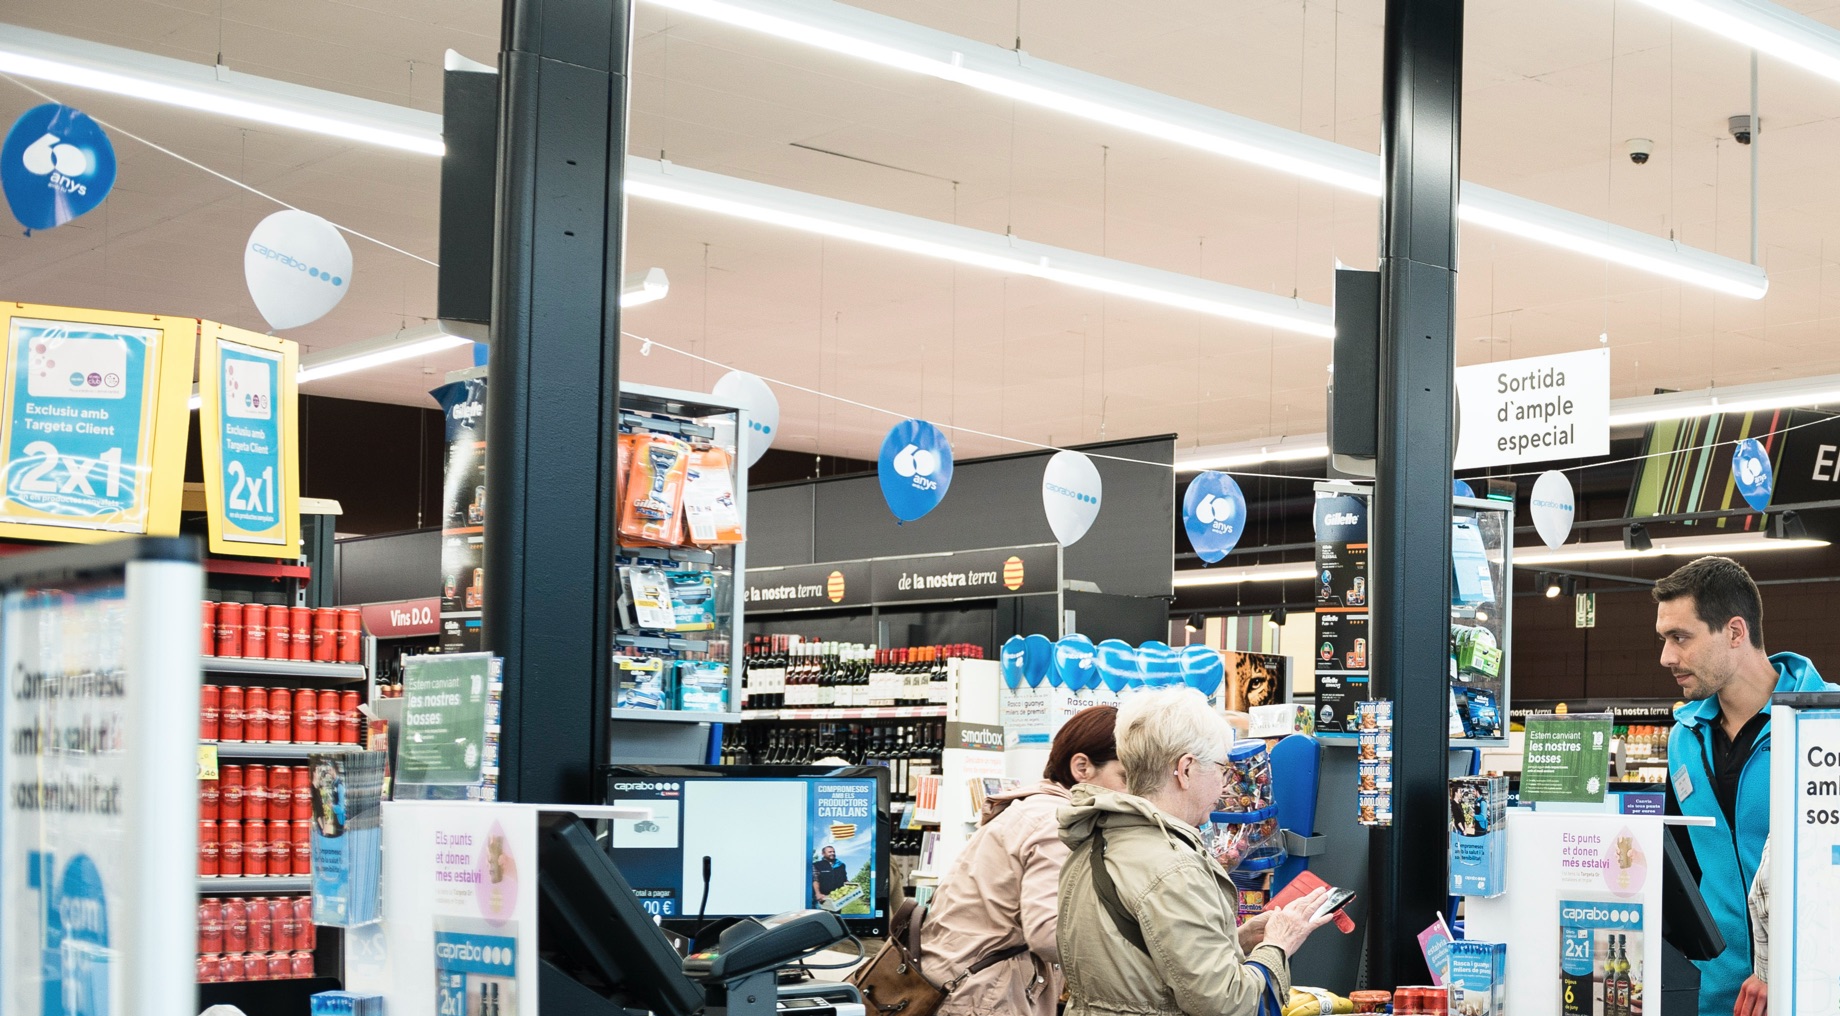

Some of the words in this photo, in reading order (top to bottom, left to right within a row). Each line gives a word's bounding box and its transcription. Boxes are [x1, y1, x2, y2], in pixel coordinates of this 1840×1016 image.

[50, 171, 87, 196] anys
[252, 242, 307, 271] caprabo
[1497, 367, 1566, 394] Sortida
[26, 403, 79, 418] Exclusiu
[81, 406, 109, 419] amb
[25, 418, 73, 434] Targeta
[76, 421, 115, 436] Client
[226, 424, 250, 437] Exclusiu
[250, 428, 265, 439] amb
[226, 438, 249, 452] Targeta
[250, 441, 269, 454] Client
[1497, 424, 1575, 455] especial
[20, 440, 123, 498] 2x1
[227, 460, 274, 513] 2x1
[913, 474, 937, 490] anys
[1045, 482, 1076, 498] caprabo
[1212, 520, 1234, 534] anys
[1324, 513, 1359, 526] Gillette
[898, 574, 912, 591] de
[913, 574, 925, 588] la
[926, 571, 966, 588] nostra
[968, 570, 997, 585] terra
[751, 587, 761, 600] la
[762, 585, 796, 600] nostra
[797, 584, 822, 598] terra
[390, 609, 411, 627] Vins
[412, 606, 433, 625] D.O.
[409, 678, 431, 690] Estem
[432, 676, 459, 689] canviant
[408, 692, 424, 708] les
[424, 692, 461, 707] nostres
[1024, 701, 1044, 709] guanya
[1067, 697, 1094, 707] Rasca
[406, 710, 441, 726] bosses
[1614, 707, 1621, 715] la
[1622, 707, 1649, 716] nostra
[1650, 707, 1669, 715] terra
[961, 729, 1003, 746] smartbox
[1531, 731, 1551, 740] Estem
[1552, 731, 1581, 740] canviant
[1530, 740, 1543, 751] les
[1545, 741, 1581, 752] nostres
[1528, 752, 1561, 763] bosses
[614, 781, 654, 792] caprabo
[818, 785, 869, 793] COMPROMESOS
[818, 798, 868, 807] PRODUCTORS
[818, 807, 868, 818] CATALANS
[436, 831, 448, 845] Els
[450, 833, 472, 848] punts
[1562, 832, 1575, 842] Els
[1577, 835, 1601, 845] punts
[436, 853, 443, 864] et
[446, 852, 470, 865] donen
[1563, 846, 1571, 855] et
[1573, 846, 1598, 856] donen
[1562, 857, 1580, 868] més
[1582, 859, 1610, 869] estalvi
[436, 867, 453, 882] més
[454, 869, 482, 884] estalvi
[653, 890, 671, 898] pagar
[663, 900, 673, 915] €
[1563, 906, 1609, 922] caprabo
[436, 941, 481, 962] caprabo
[1565, 939, 1590, 958] 2x1
[440, 988, 463, 1016] 2x1
[1564, 985, 1575, 1004] 6
